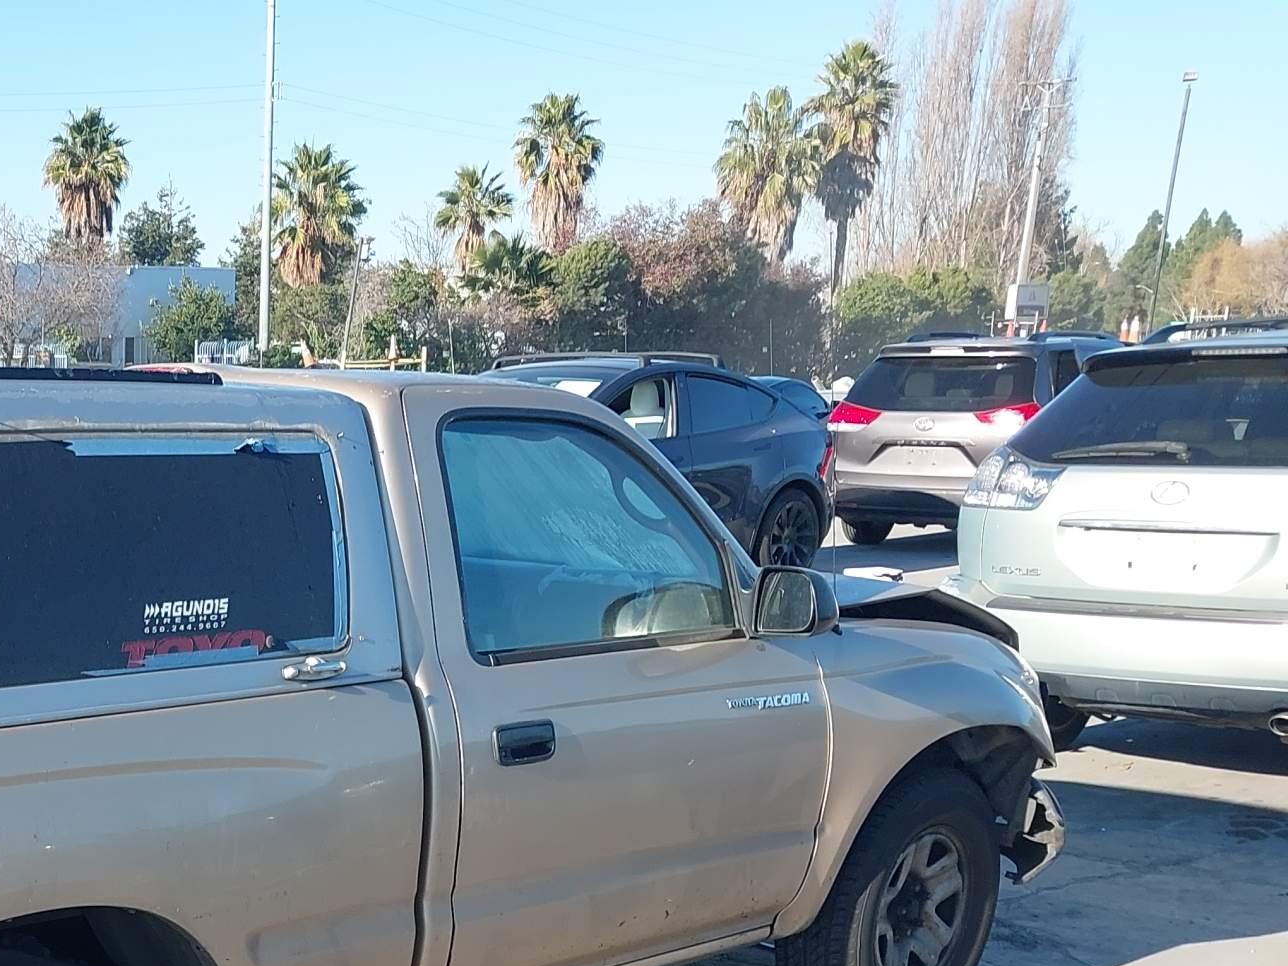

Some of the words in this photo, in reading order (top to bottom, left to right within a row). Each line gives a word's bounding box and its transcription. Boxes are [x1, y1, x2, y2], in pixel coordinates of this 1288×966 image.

[991, 564, 1042, 577] LEXUS
[143, 616, 182, 626] TIRE
[188, 613, 228, 623] SHOP
[756, 691, 811, 711] TACOMA
